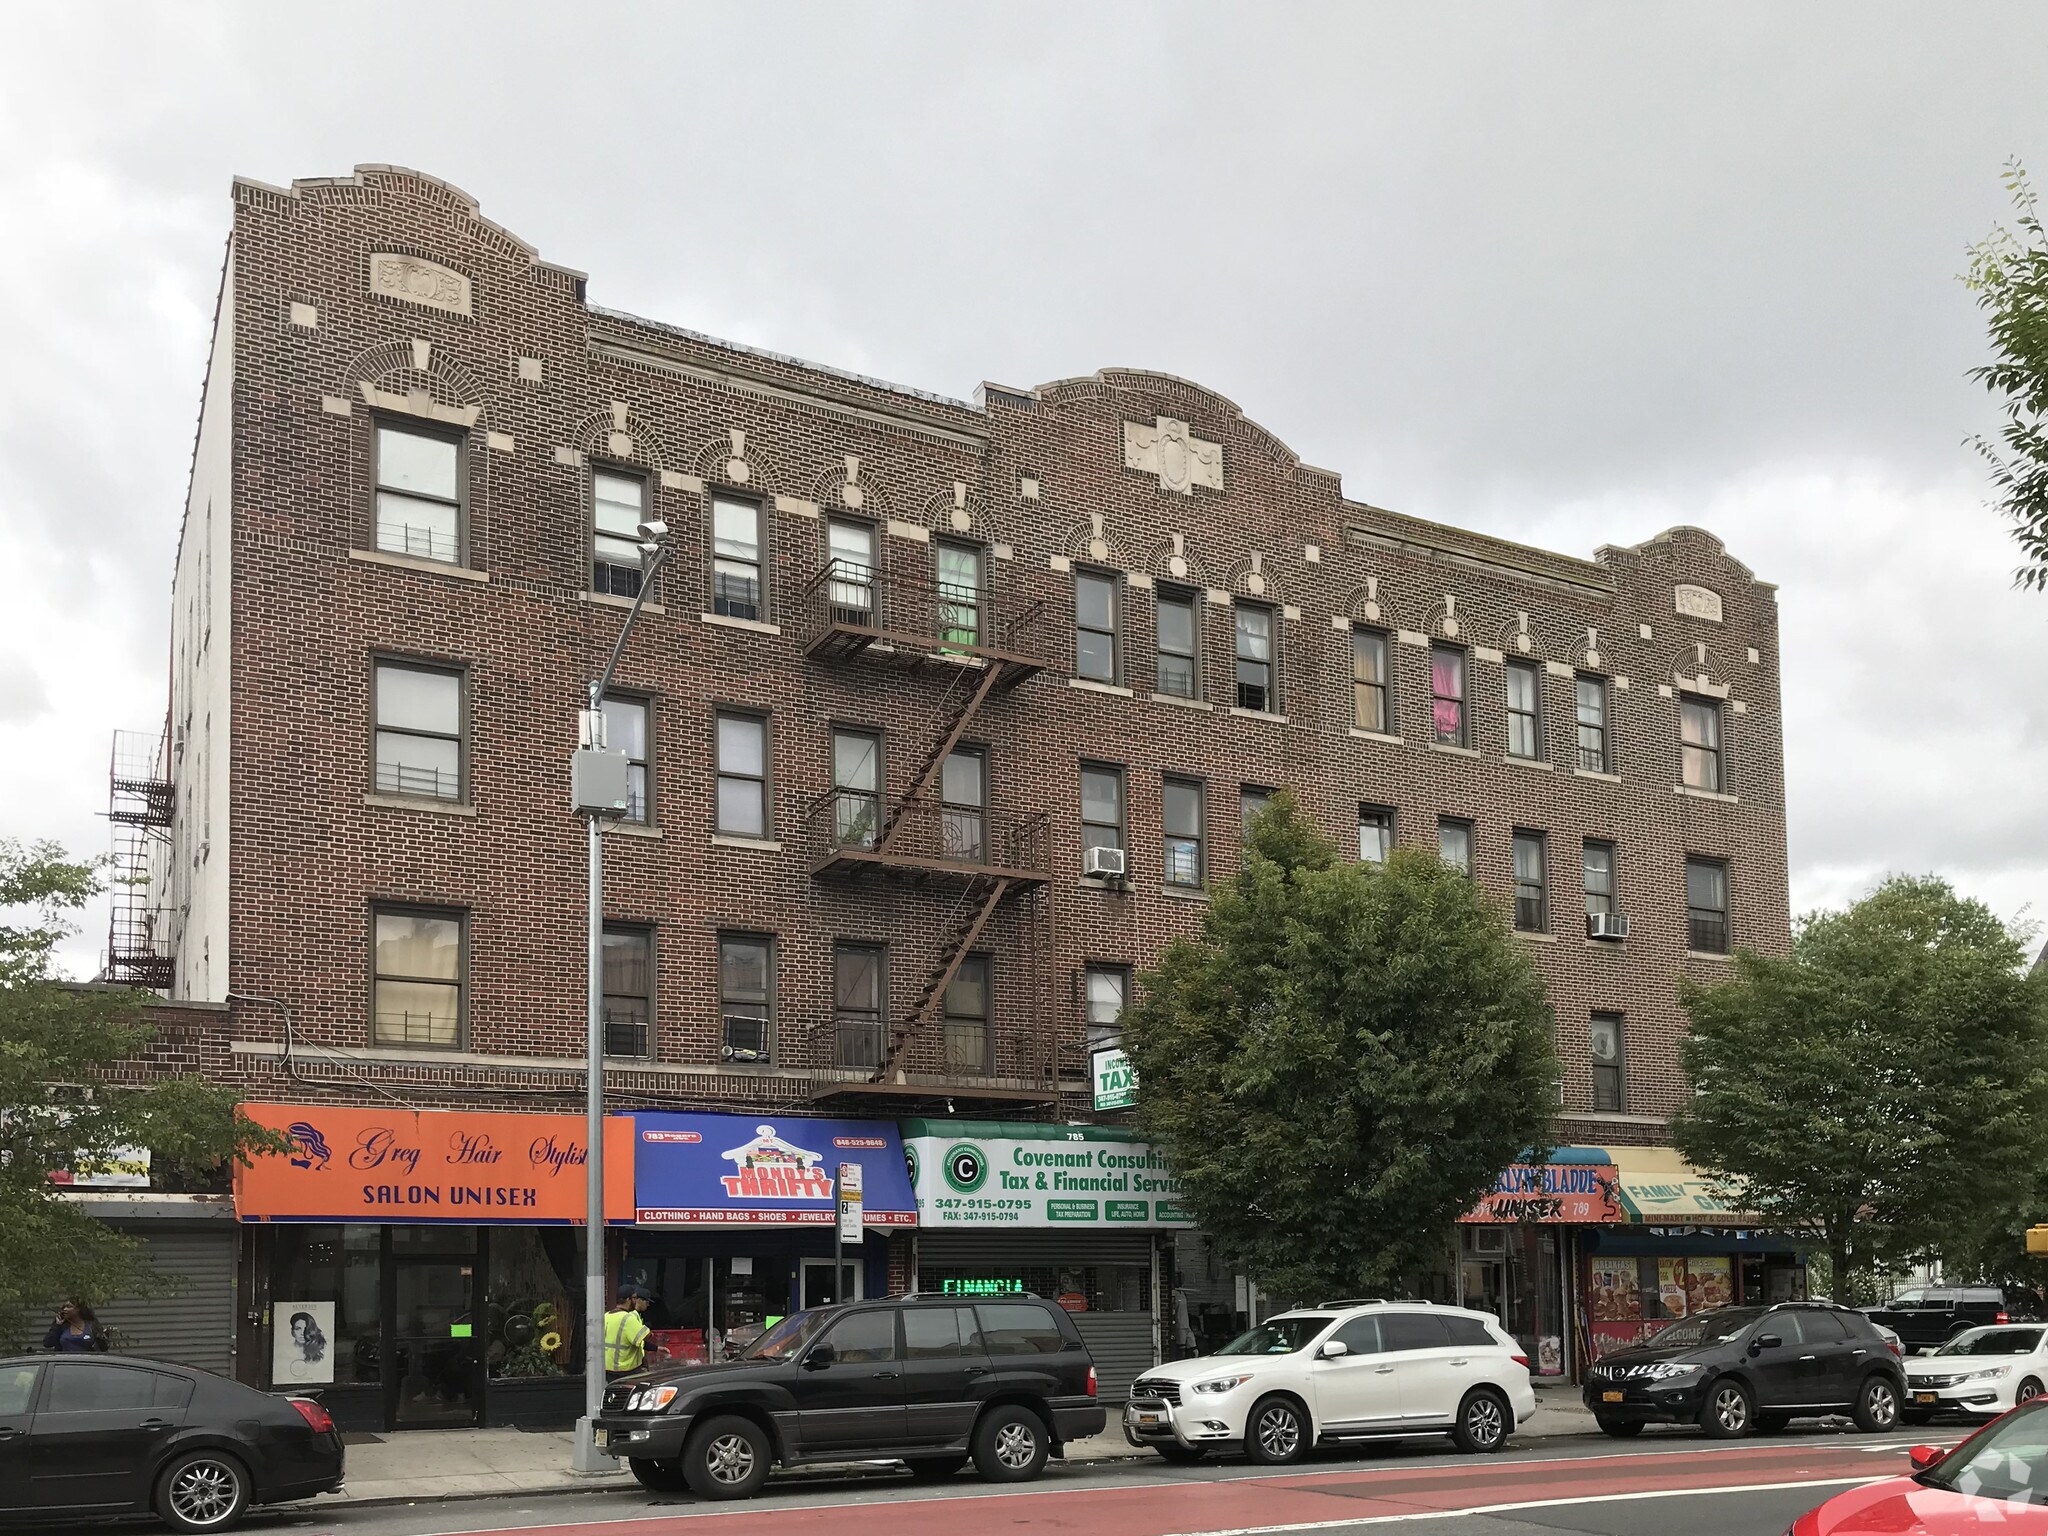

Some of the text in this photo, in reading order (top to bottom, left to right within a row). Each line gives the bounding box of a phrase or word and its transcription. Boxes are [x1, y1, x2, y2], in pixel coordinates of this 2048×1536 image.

[1100, 1068, 1133, 1091] TAX
[1067, 1133, 1084, 1141] 785
[446, 1130, 503, 1164] Hair
[1013, 1147, 1170, 1171] Covenant Consultin
[740, 1167, 824, 1180] MONDY'S
[958, 1158, 973, 1178] C
[723, 1178, 833, 1197] THRIFTY
[999, 1170, 1031, 1190] Tax
[1034, 1171, 1049, 1190] &
[1053, 1170, 1129, 1192] Financial
[1542, 1168, 1598, 1194] BLADDE
[363, 1185, 537, 1206] SALON UNISEX
[1627, 1183, 1688, 1199] FAMILY
[935, 1199, 1032, 1210] 347-915-0795
[1051, 1202, 1071, 1210] PERSONAL
[1573, 1202, 1590, 1216] 789
[644, 1211, 691, 1220] CLOTHING
[699, 1212, 725, 1220] HAND
[726, 1212, 750, 1221] BAGS
[758, 1212, 787, 1221] SHOES
[798, 1213, 836, 1222] JEWELRY
[893, 1214, 912, 1222] ETC.
[943, 1211, 1019, 1221] FAX: 347-915-0794
[1595, 1260, 1633, 1270] BREAKFAST
